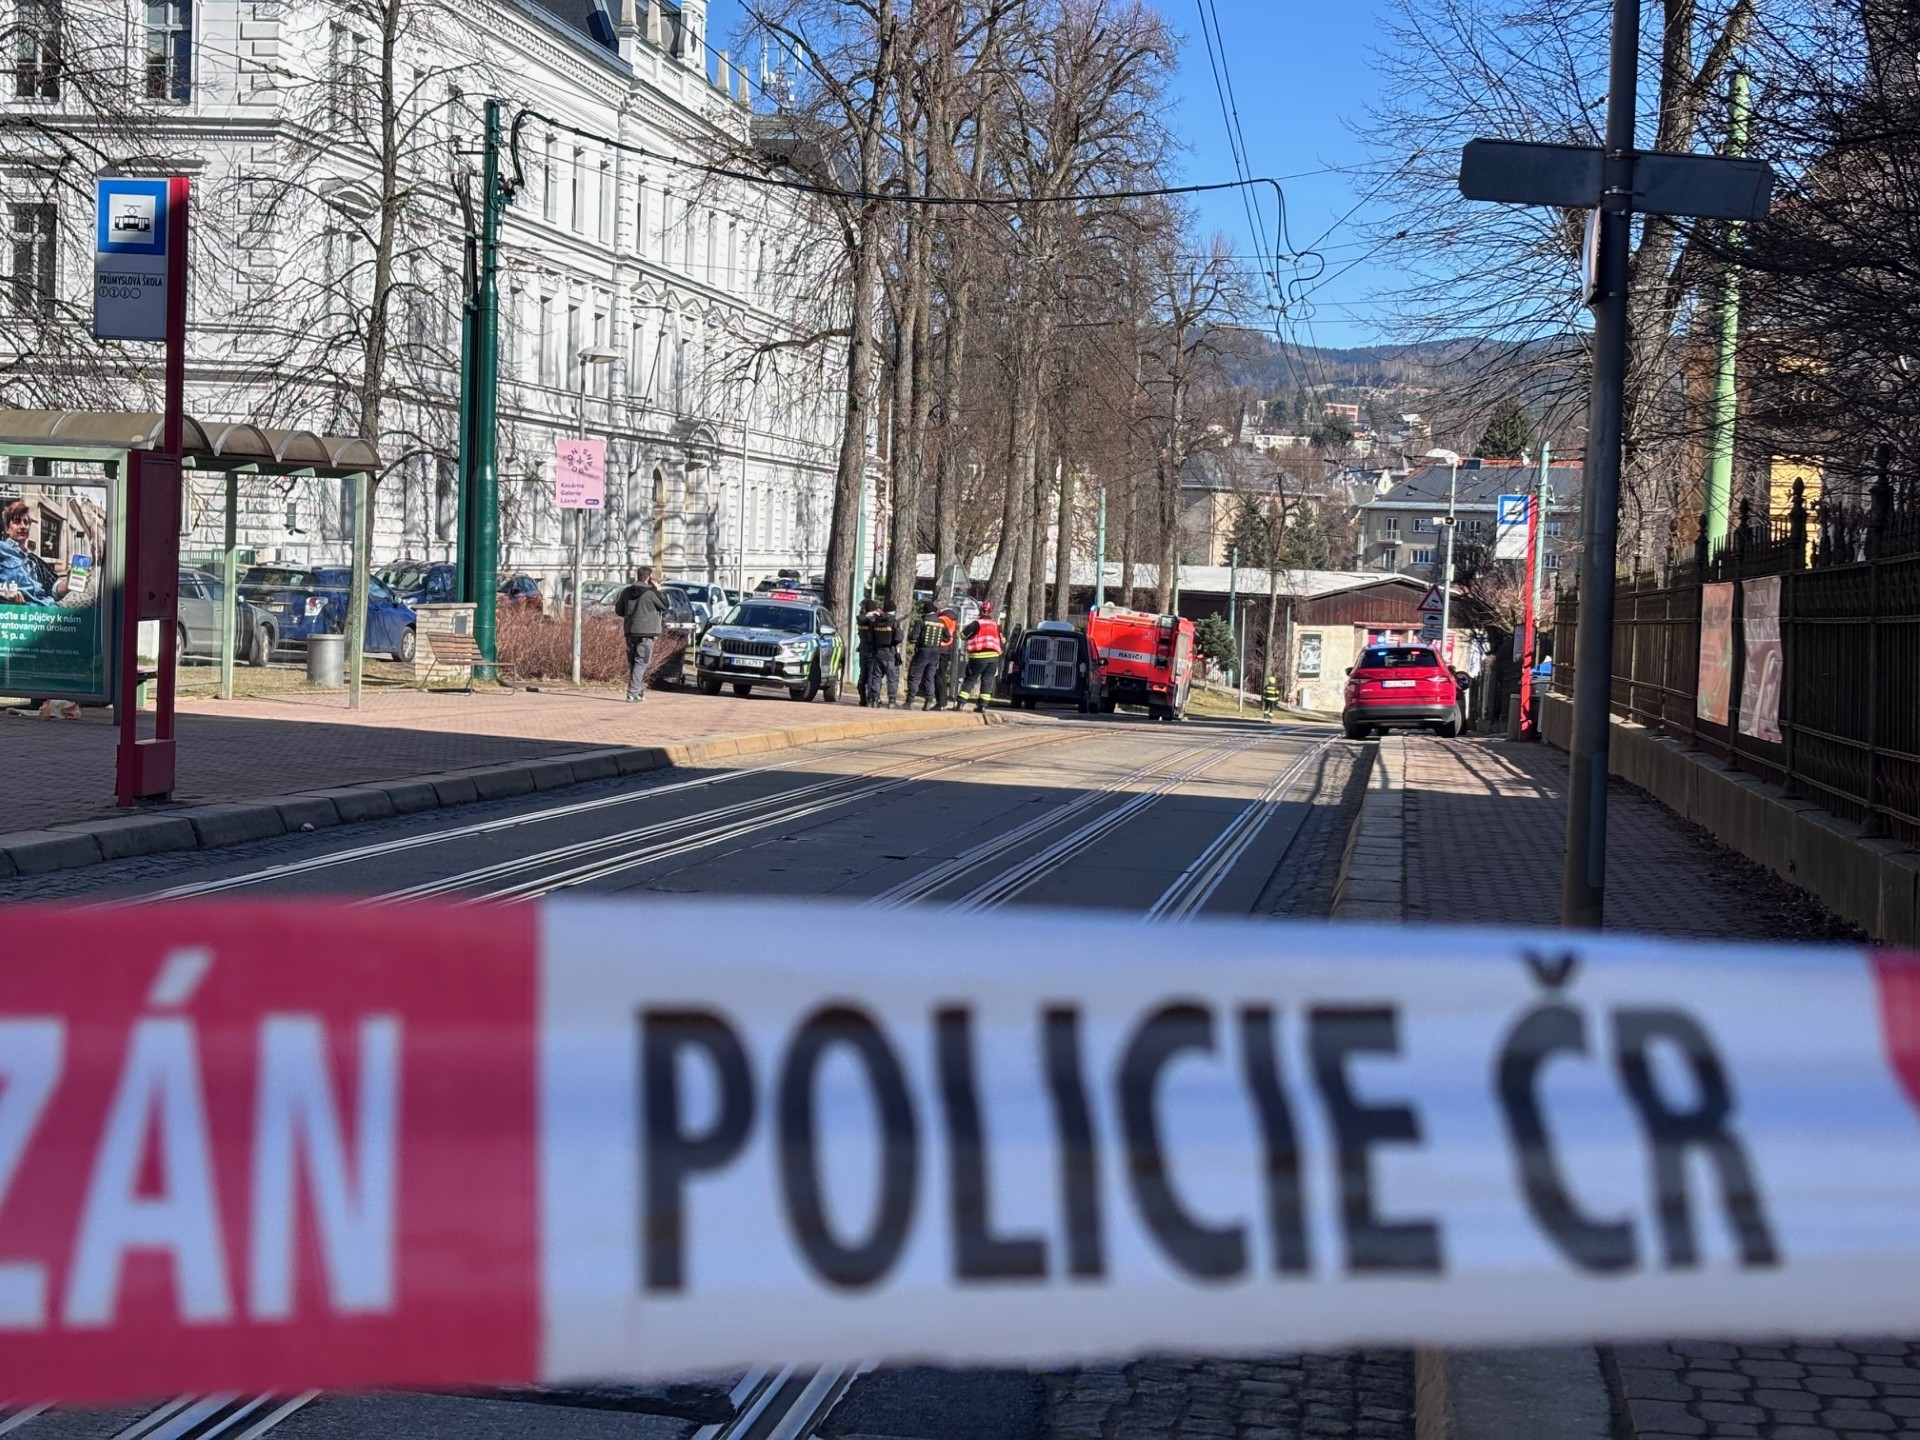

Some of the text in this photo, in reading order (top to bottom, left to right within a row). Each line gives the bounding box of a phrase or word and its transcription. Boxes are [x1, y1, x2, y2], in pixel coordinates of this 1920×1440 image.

[100, 273, 163, 287] PRŮMYSLOVÁ ŠKOLA
[20, 612, 27, 620] si
[29, 612, 55, 624] půjčky
[57, 614, 62, 622] k
[63, 614, 81, 623] nám
[46, 623, 76, 632] úrokem
[1, 631, 8, 639] %
[637, 997, 1445, 1292] POLICIE
[1496, 946, 1782, 1275] ČR
